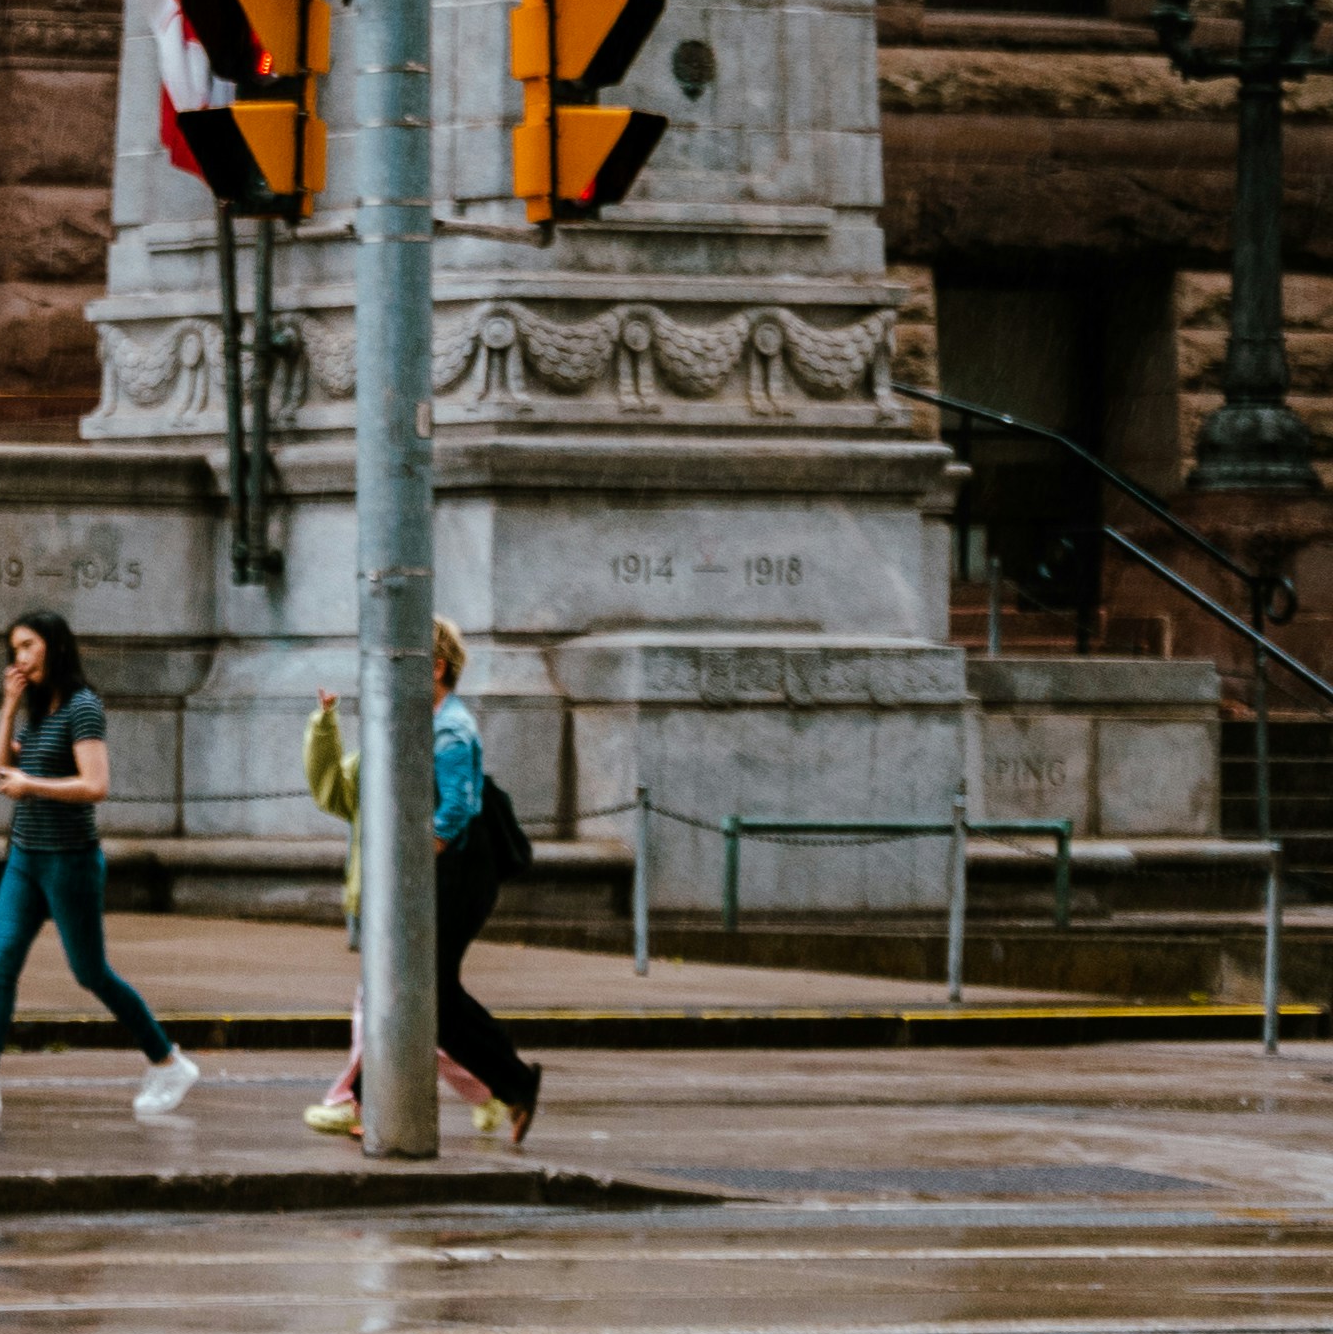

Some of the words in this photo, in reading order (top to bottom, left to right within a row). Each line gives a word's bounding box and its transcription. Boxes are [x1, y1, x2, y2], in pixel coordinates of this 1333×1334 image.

[69, 558, 144, 590] 1945
[609, 553, 676, 586] 1914
[743, 554, 805, 587] 1918
